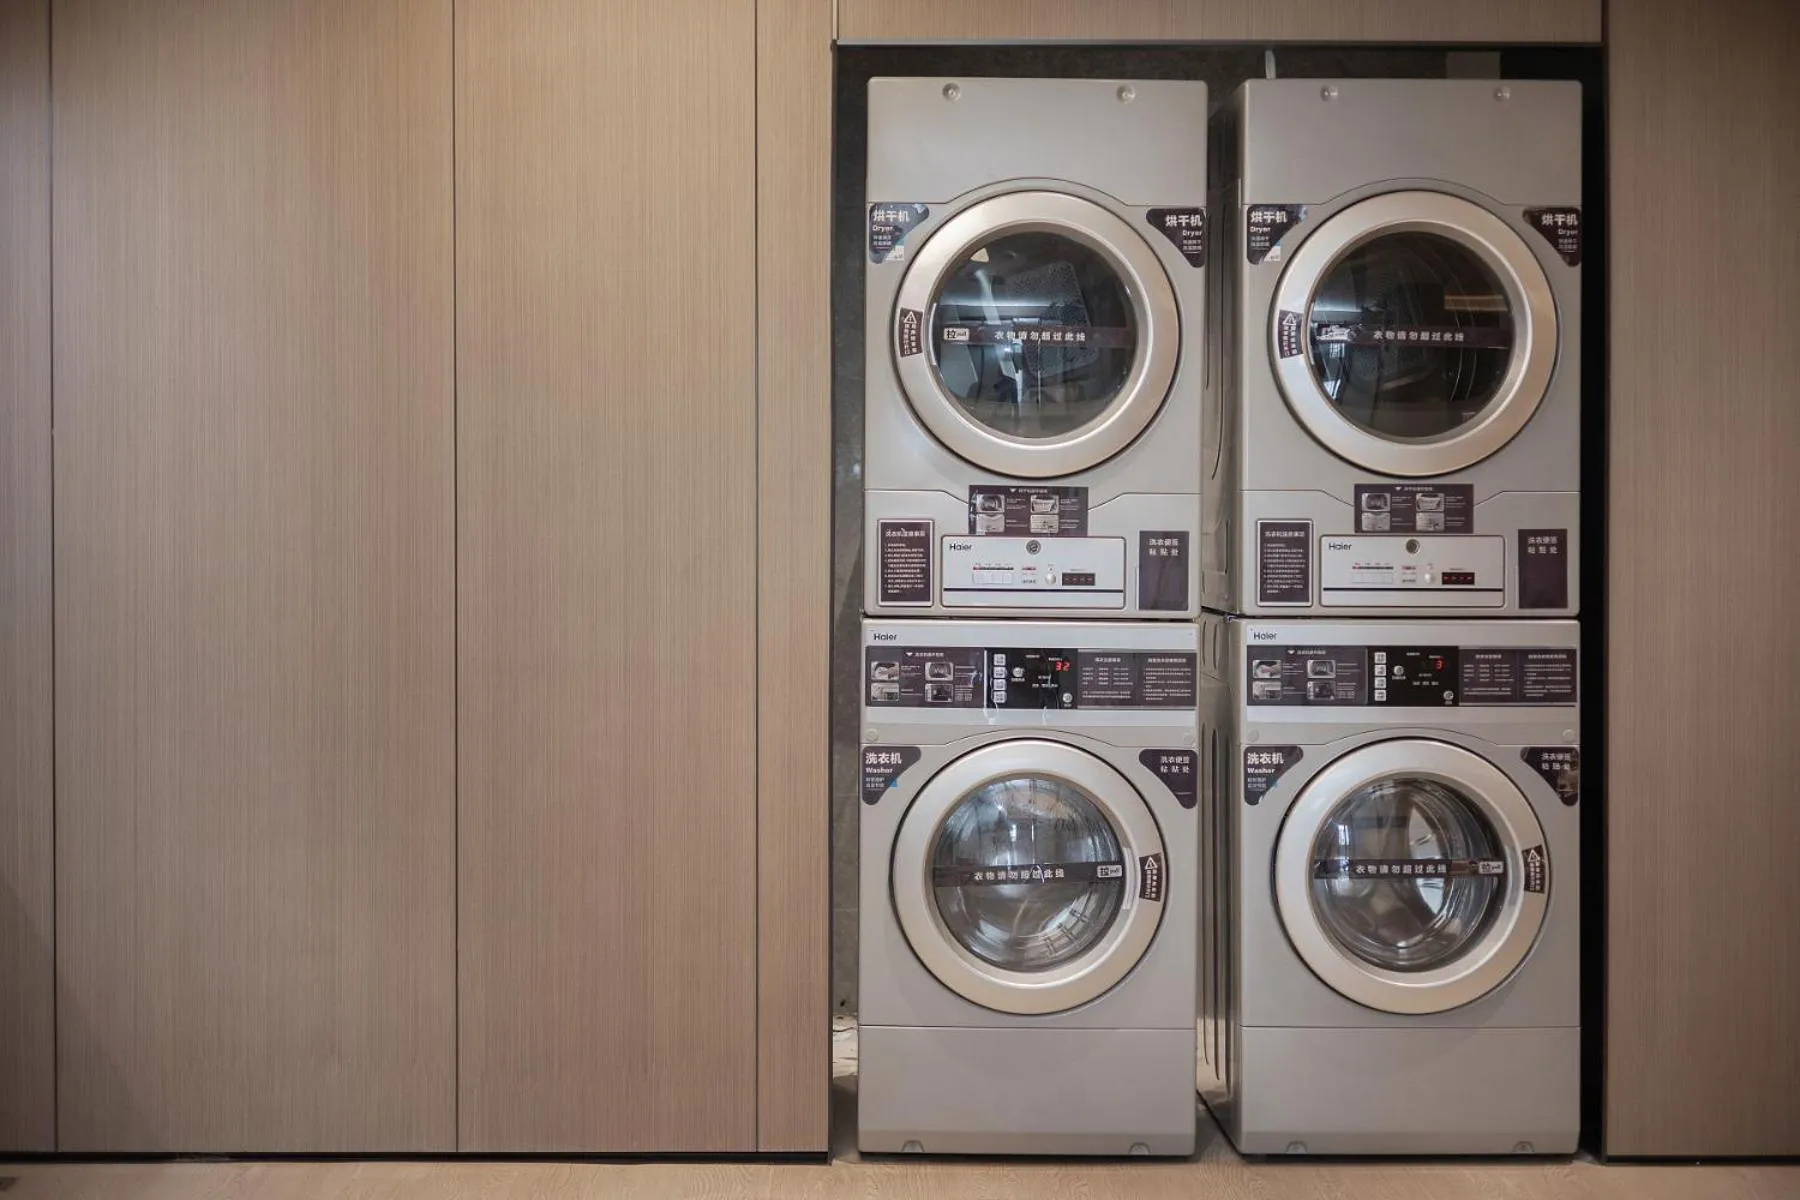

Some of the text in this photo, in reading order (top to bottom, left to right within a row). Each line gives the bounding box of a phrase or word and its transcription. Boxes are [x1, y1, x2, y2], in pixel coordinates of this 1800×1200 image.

[873, 209, 910, 222] 烘干机
[1165, 214, 1202, 227] 烘干机
[1250, 211, 1288, 223] 烘干机
[1541, 213, 1578, 226] 烘干机
[1182, 229, 1202, 238] Dryer
[1250, 226, 1271, 234] Dryer
[994, 331, 1086, 341] 衣物请勿超过此线
[1373, 330, 1464, 342] 衣物请勿超过此线
[949, 543, 973, 551] Haier
[1328, 542, 1352, 550] Haier
[873, 633, 897, 641] Haier
[1253, 631, 1277, 640] Haier
[1055, 660, 1071, 672] 32
[1435, 659, 1443, 670] 3
[865, 752, 902, 764] 洗衣机
[1247, 752, 1284, 764] 洗衣机
[1355, 864, 1447, 874] 衣物请勿超过此线
